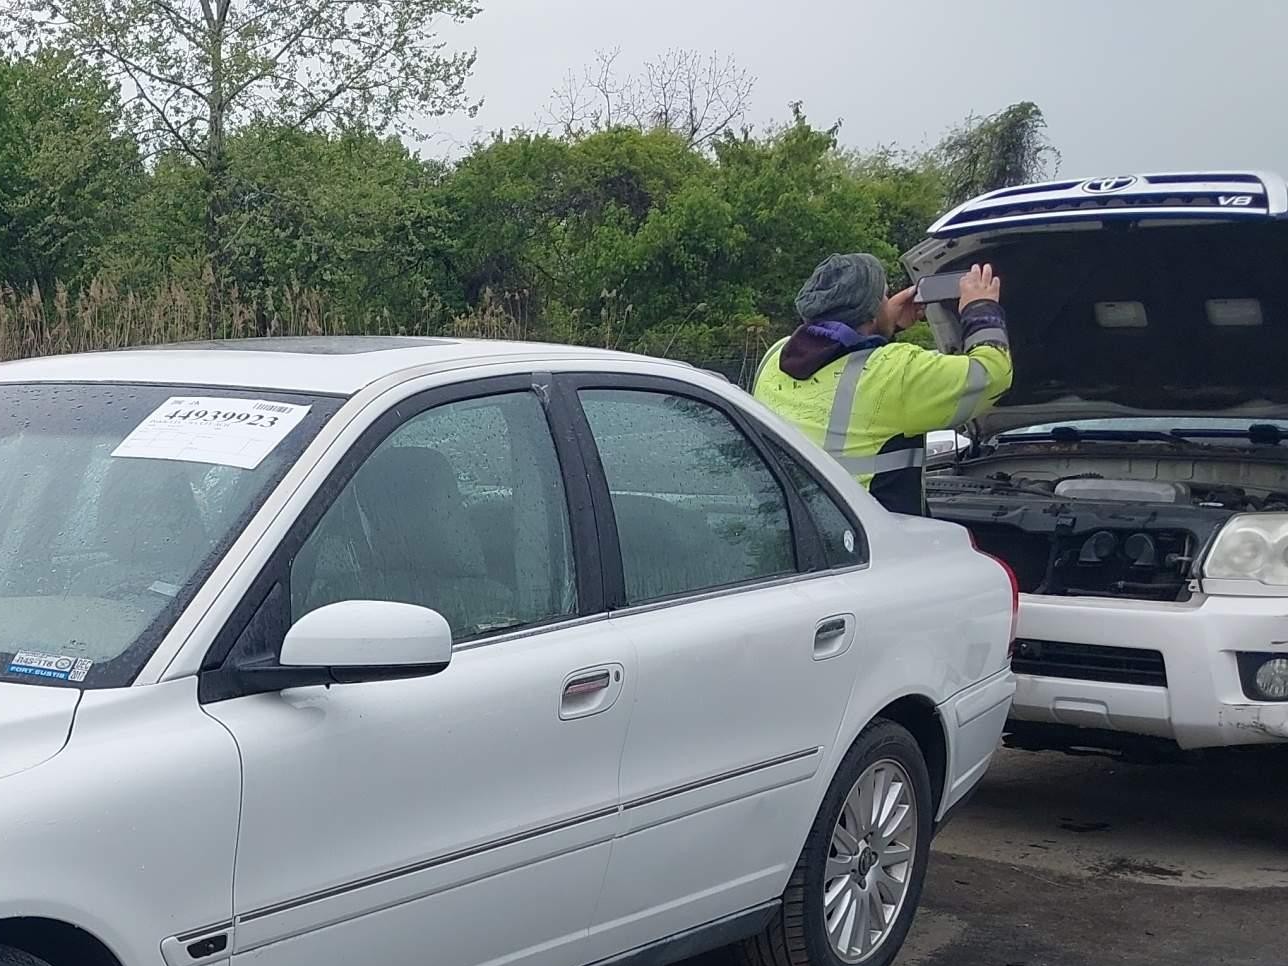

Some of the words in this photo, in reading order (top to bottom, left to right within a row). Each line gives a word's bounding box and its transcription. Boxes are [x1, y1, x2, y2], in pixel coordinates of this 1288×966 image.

[1218, 195, 1252, 206] V8
[164, 409, 279, 428] 44939923
[9, 666, 34, 674] FORT
